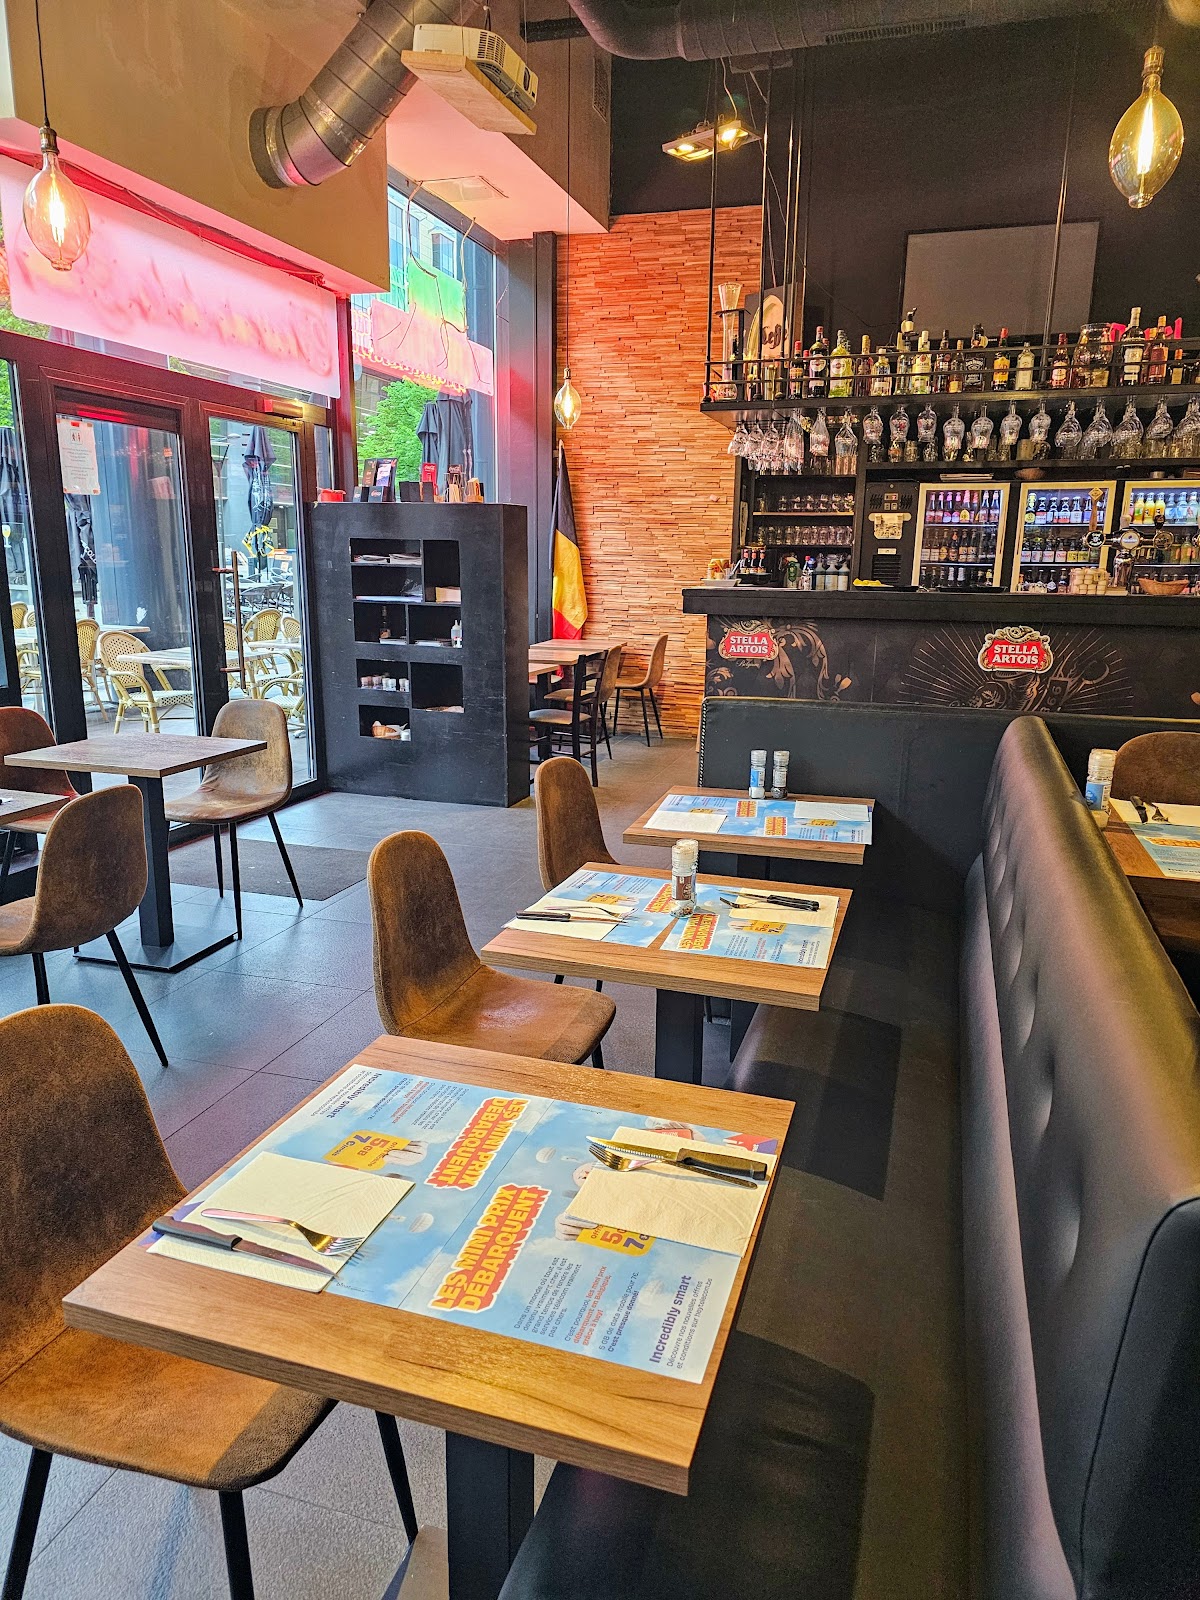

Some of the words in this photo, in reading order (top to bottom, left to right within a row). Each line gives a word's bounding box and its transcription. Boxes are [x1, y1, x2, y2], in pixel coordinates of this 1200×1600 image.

[729, 645, 768, 654] ARTOIS
[730, 636, 768, 645] STELLA
[993, 644, 1039, 654] STELLA
[992, 654, 1039, 664] ARTOIS
[344, 1072, 383, 1100] Incredibly
[325, 1099, 351, 1119] smart
[500, 1098, 529, 1119] LES
[435, 1097, 510, 1184] DÉBARQUENT
[481, 1120, 514, 1150] MINI
[456, 1151, 494, 1186] PRIX
[430, 1271, 470, 1308] LES
[453, 1228, 494, 1270] MINI
[479, 1186, 518, 1227] PRIX
[455, 1189, 539, 1310] DÉBARQUENT
[549, 1256, 560, 1266] est
[564, 1262, 574, 1271] les
[542, 1264, 555, 1278] tout
[554, 1270, 570, 1289] rendre
[595, 1264, 608, 1277] prix
[589, 1276, 602, 1289] mini
[624, 1279, 637, 1293] pour
[690, 1279, 704, 1298] offres
[521, 1308, 540, 1331] devenu
[533, 1283, 554, 1309] vraiment
[558, 1256, 569, 1267] est
[526, 1284, 544, 1305] monde
[537, 1309, 557, 1335] services
[551, 1286, 570, 1310] télécom
[564, 1263, 582, 1287] vraiment
[549, 1288, 560, 1297] de
[584, 1288, 595, 1299] les
[522, 1304, 532, 1314] un
[539, 1296, 556, 1315] temps
[614, 1292, 630, 1312] mobile
[680, 1297, 698, 1325] nouvelles
[512, 1312, 527, 1329] Dans
[529, 1314, 546, 1334] grand
[571, 1307, 596, 1344] débarquent
[589, 1299, 599, 1308] en
[608, 1311, 621, 1327] data
[647, 1305, 681, 1364] Incredibly
[671, 1274, 692, 1306] smart
[689, 1317, 699, 1328] sur
[546, 1325, 559, 1338] pas
[563, 1325, 577, 1342] C'est
[599, 1334, 610, 1345] GB
[604, 1326, 614, 1335] de
[606, 1334, 620, 1352] C'est
[614, 1310, 632, 1336] presque
[676, 1324, 688, 1337] nos
[665, 1336, 683, 1367] Découvre
[676, 1327, 696, 1361] conditions
[674, 1361, 684, 1369] et
